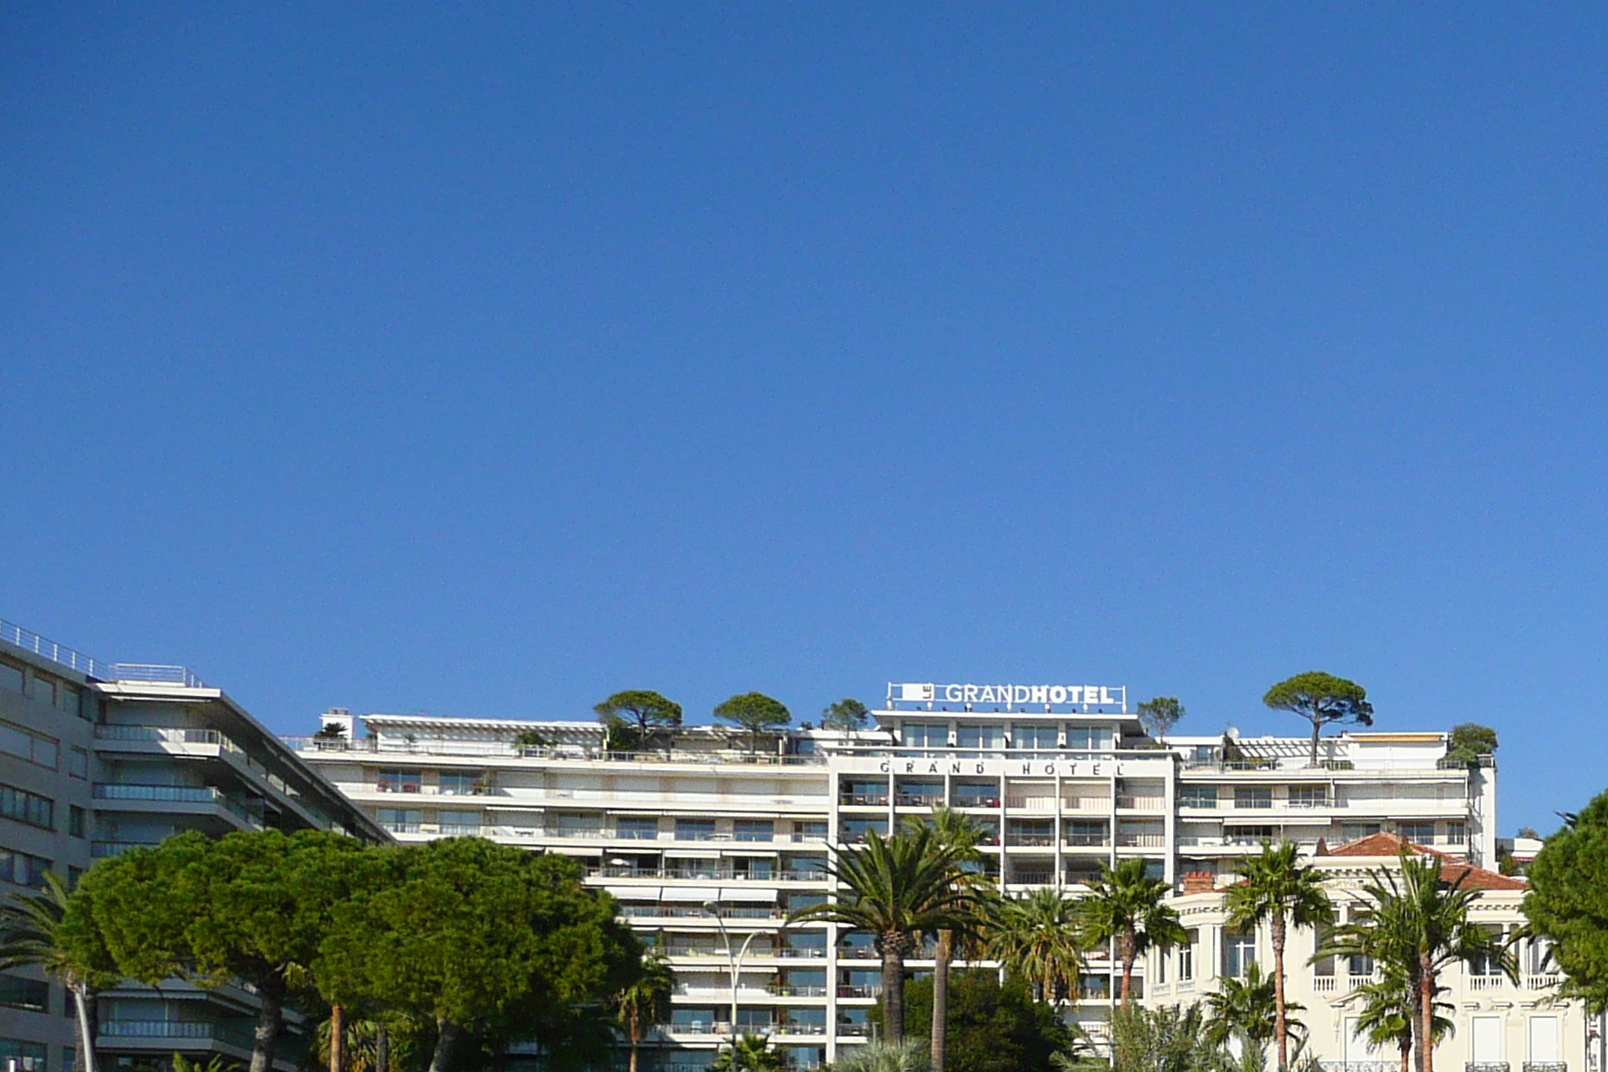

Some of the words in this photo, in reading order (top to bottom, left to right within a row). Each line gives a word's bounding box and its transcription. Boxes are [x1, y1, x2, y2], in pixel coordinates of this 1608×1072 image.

[922, 685, 933, 699] LE
[945, 684, 1114, 704] GRANDHOTEL
[880, 760, 985, 775] GRAND
[1022, 763, 1124, 776] HOTEL
